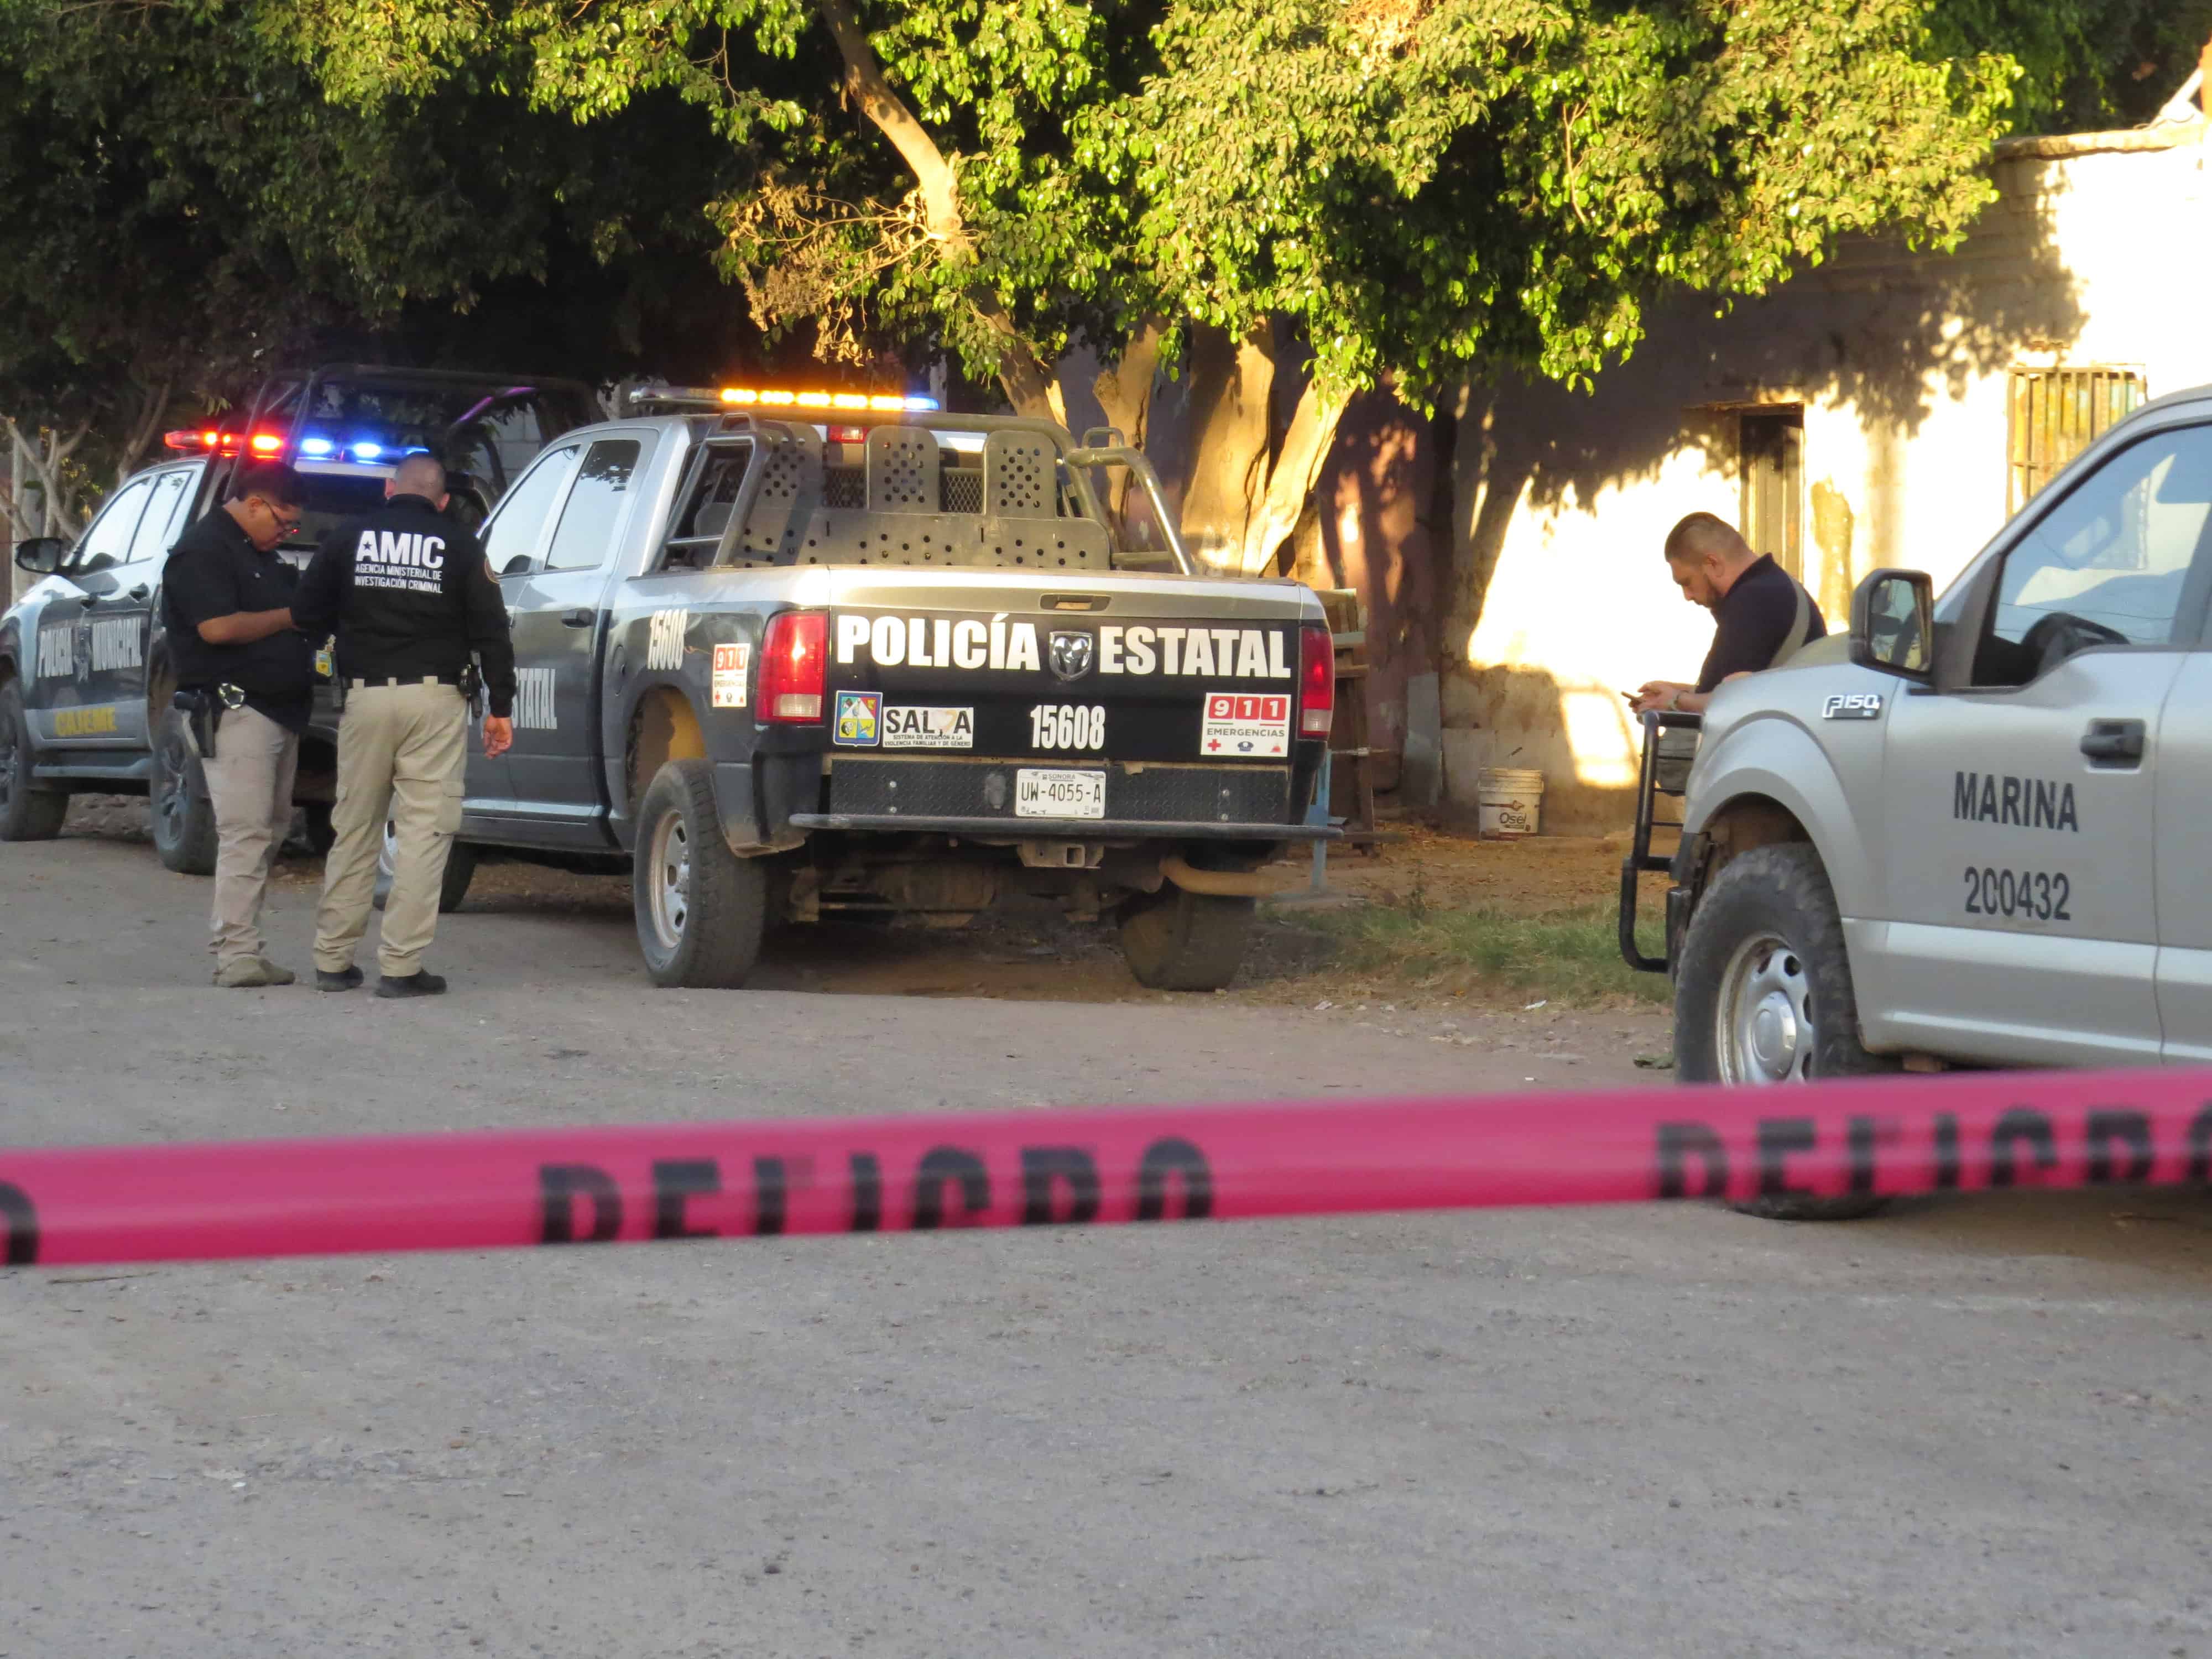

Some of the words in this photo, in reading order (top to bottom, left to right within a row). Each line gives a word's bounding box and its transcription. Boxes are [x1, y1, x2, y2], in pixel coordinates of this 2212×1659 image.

[356, 530, 446, 568] AMIC
[355, 563, 385, 575] AGENCIA
[388, 565, 431, 579] MINISTERIAL
[433, 570, 443, 580] DE
[354, 575, 406, 589] INVESTIGACIÓN
[408, 580, 443, 593] CRIMINAL
[93, 617, 142, 671] MUNICIPAL
[648, 609, 687, 670] 15608
[837, 613, 1041, 670] POLICÍA
[1099, 626, 1291, 677] ESTATAL
[717, 651, 744, 669] 911
[512, 666, 557, 729] TATAL
[1214, 699, 1279, 717] 911
[1823, 695, 1880, 718] F150
[886, 709, 971, 734] SALA
[1030, 705, 1105, 749] 15608
[1207, 728, 1285, 737] EMERGENCIAS
[1021, 781, 1100, 803] UW-4055-A
[1954, 771, 2078, 832] MARINA
[1499, 812, 1527, 823] Osel
